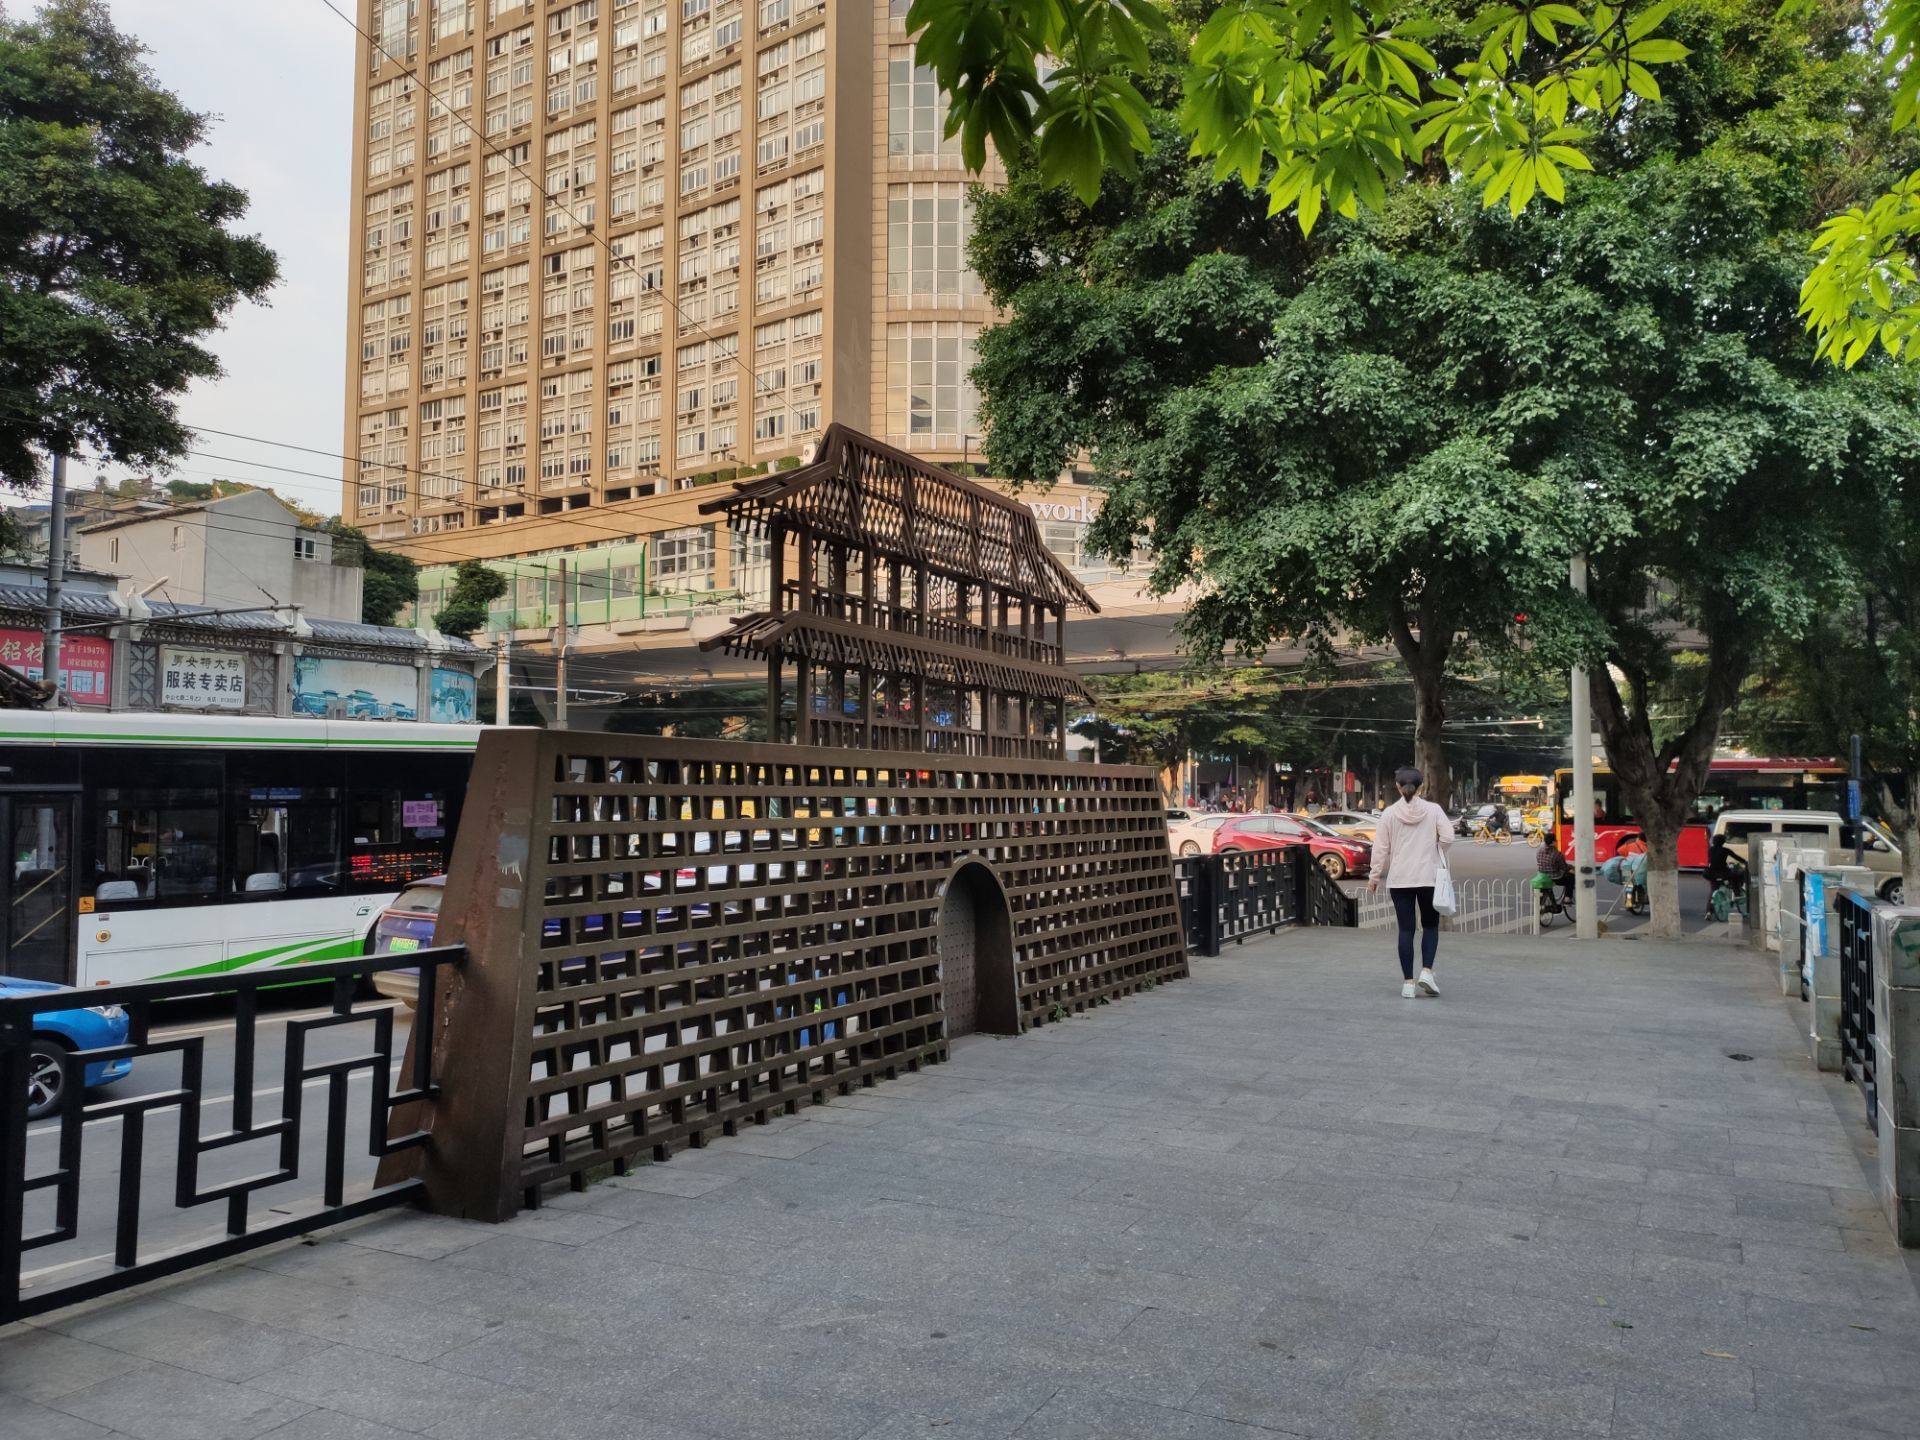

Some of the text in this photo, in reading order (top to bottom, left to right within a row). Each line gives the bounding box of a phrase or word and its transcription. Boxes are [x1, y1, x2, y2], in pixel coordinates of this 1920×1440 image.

[0, 638, 66, 662] 铝材
[171, 655, 239, 671] 男女特大码
[166, 671, 243, 692] 服装专卖店
